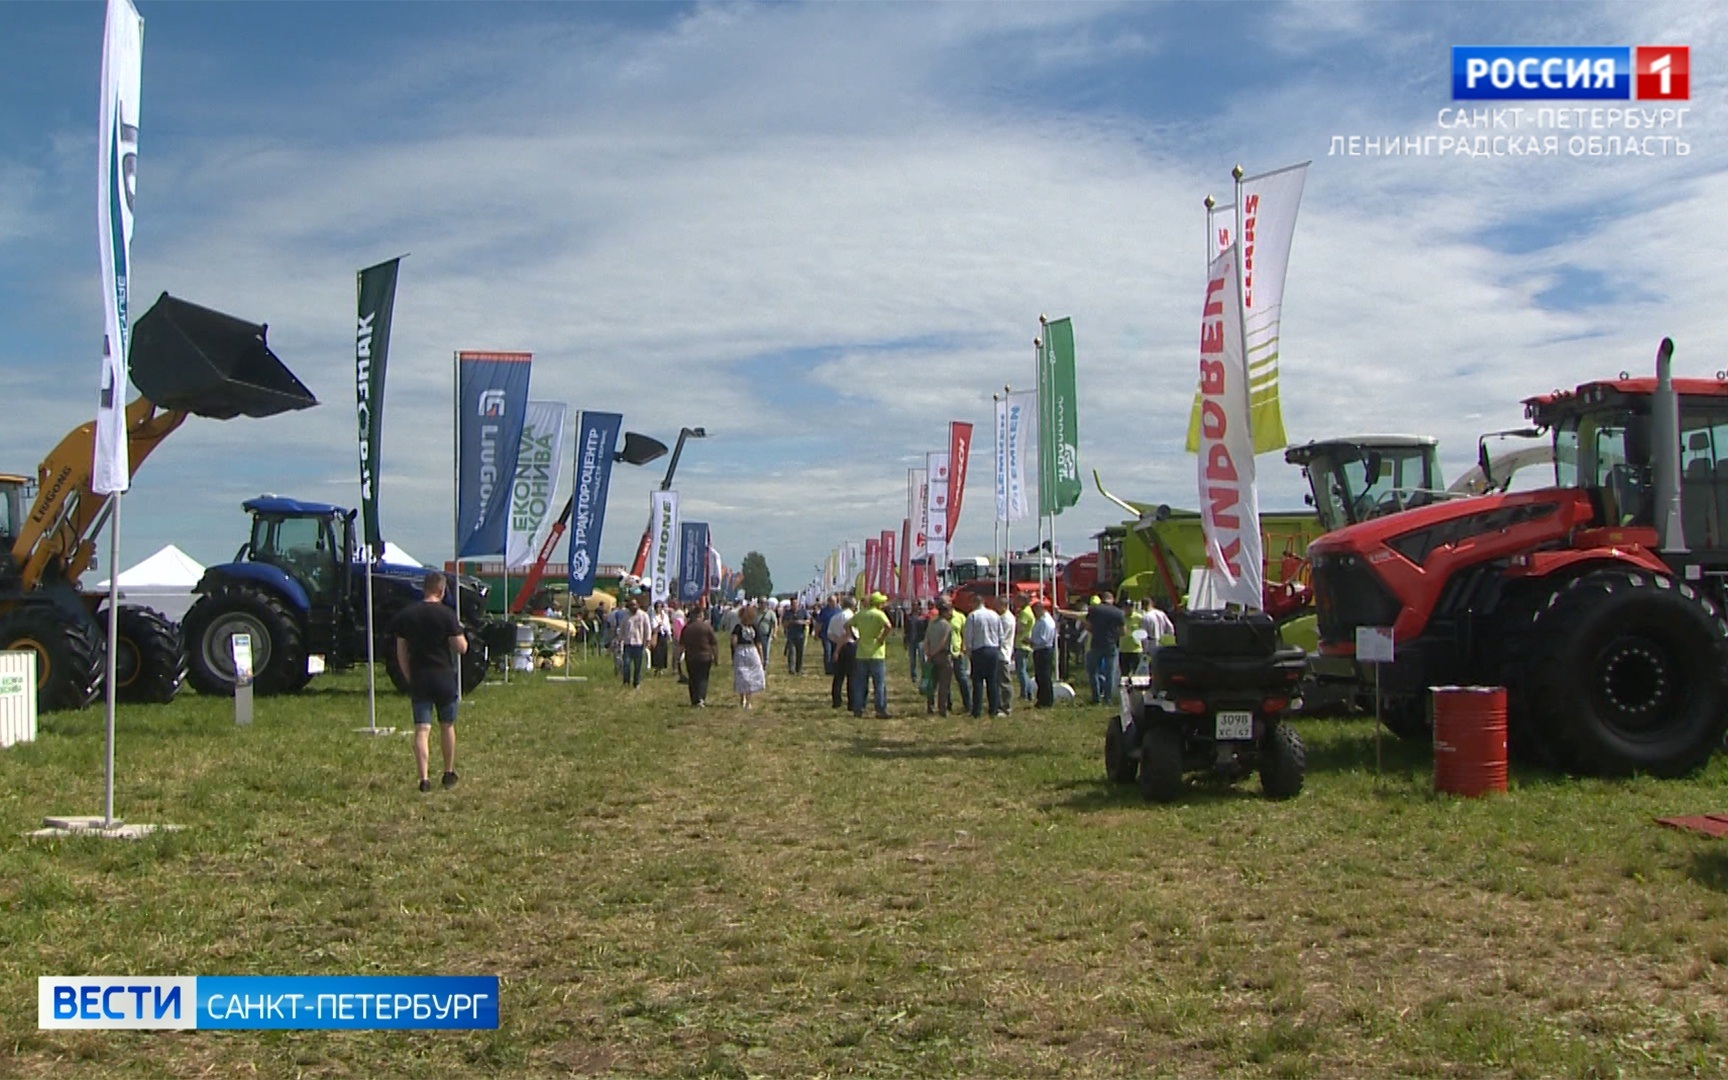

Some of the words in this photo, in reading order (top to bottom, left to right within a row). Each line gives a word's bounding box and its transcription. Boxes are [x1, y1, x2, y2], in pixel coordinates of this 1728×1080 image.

[513, 423, 536, 531] EKONIVA
[575, 427, 600, 545] ТРАКТОРОЦЕНТР
[657, 500, 672, 574] KRONE
